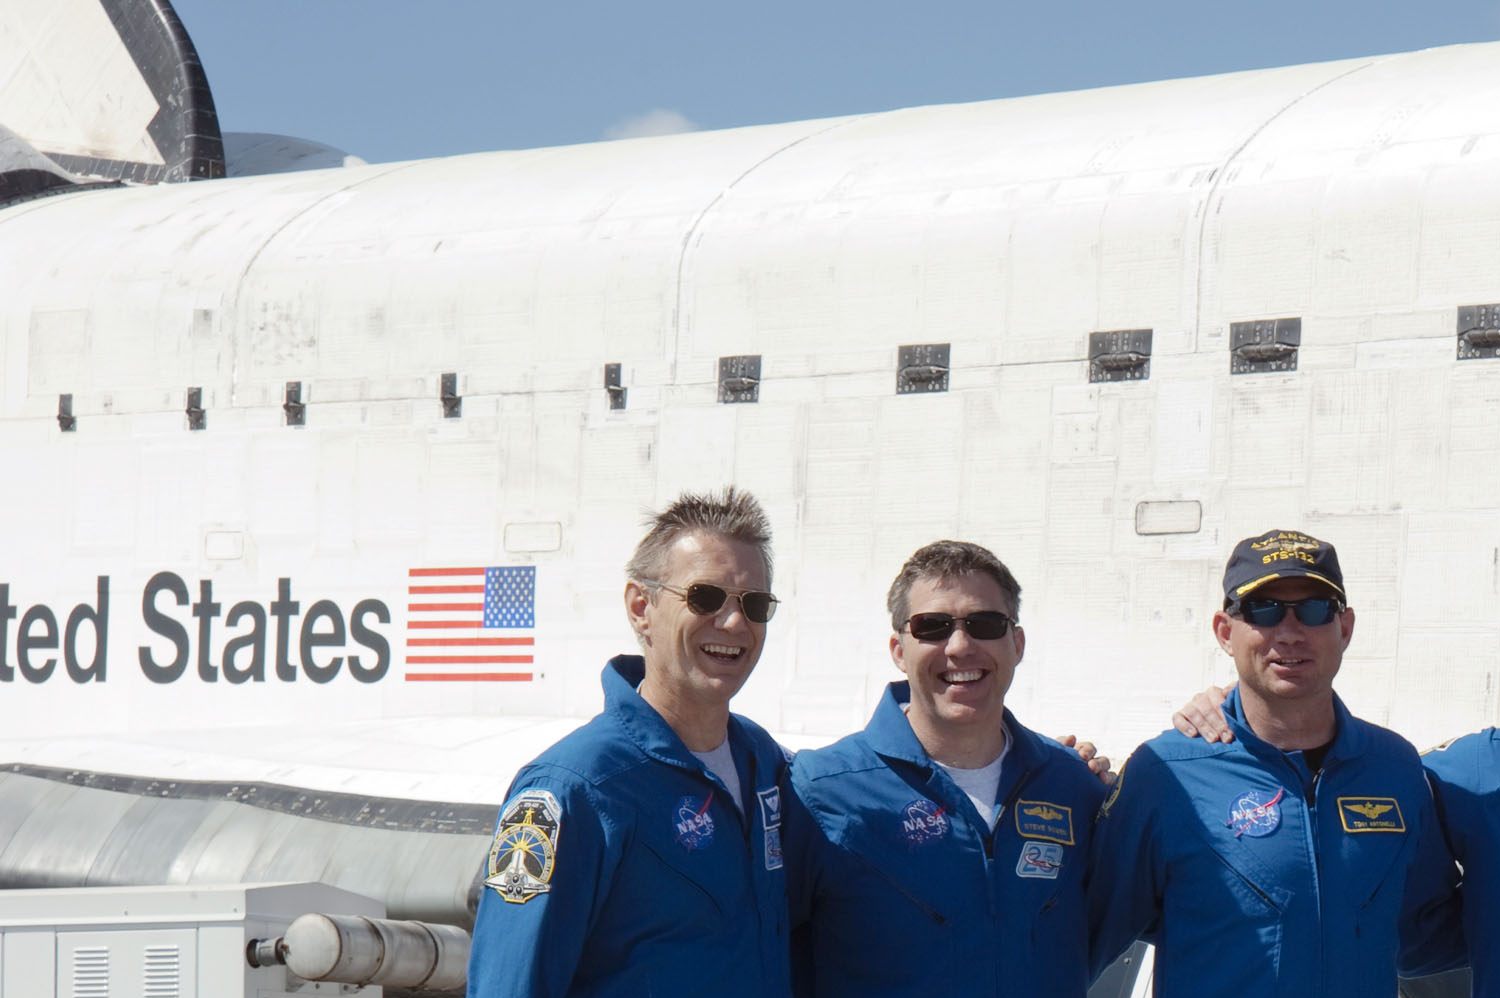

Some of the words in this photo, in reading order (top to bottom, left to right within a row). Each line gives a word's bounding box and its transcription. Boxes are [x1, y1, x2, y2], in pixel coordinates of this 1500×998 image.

[1262, 550, 1315, 564] STS-132
[0, 575, 110, 684] ted
[138, 570, 391, 685] States
[676, 812, 713, 835] NASA
[903, 813, 947, 832] NASA
[1231, 806, 1276, 822] NASA
[1023, 846, 1057, 873] 25
